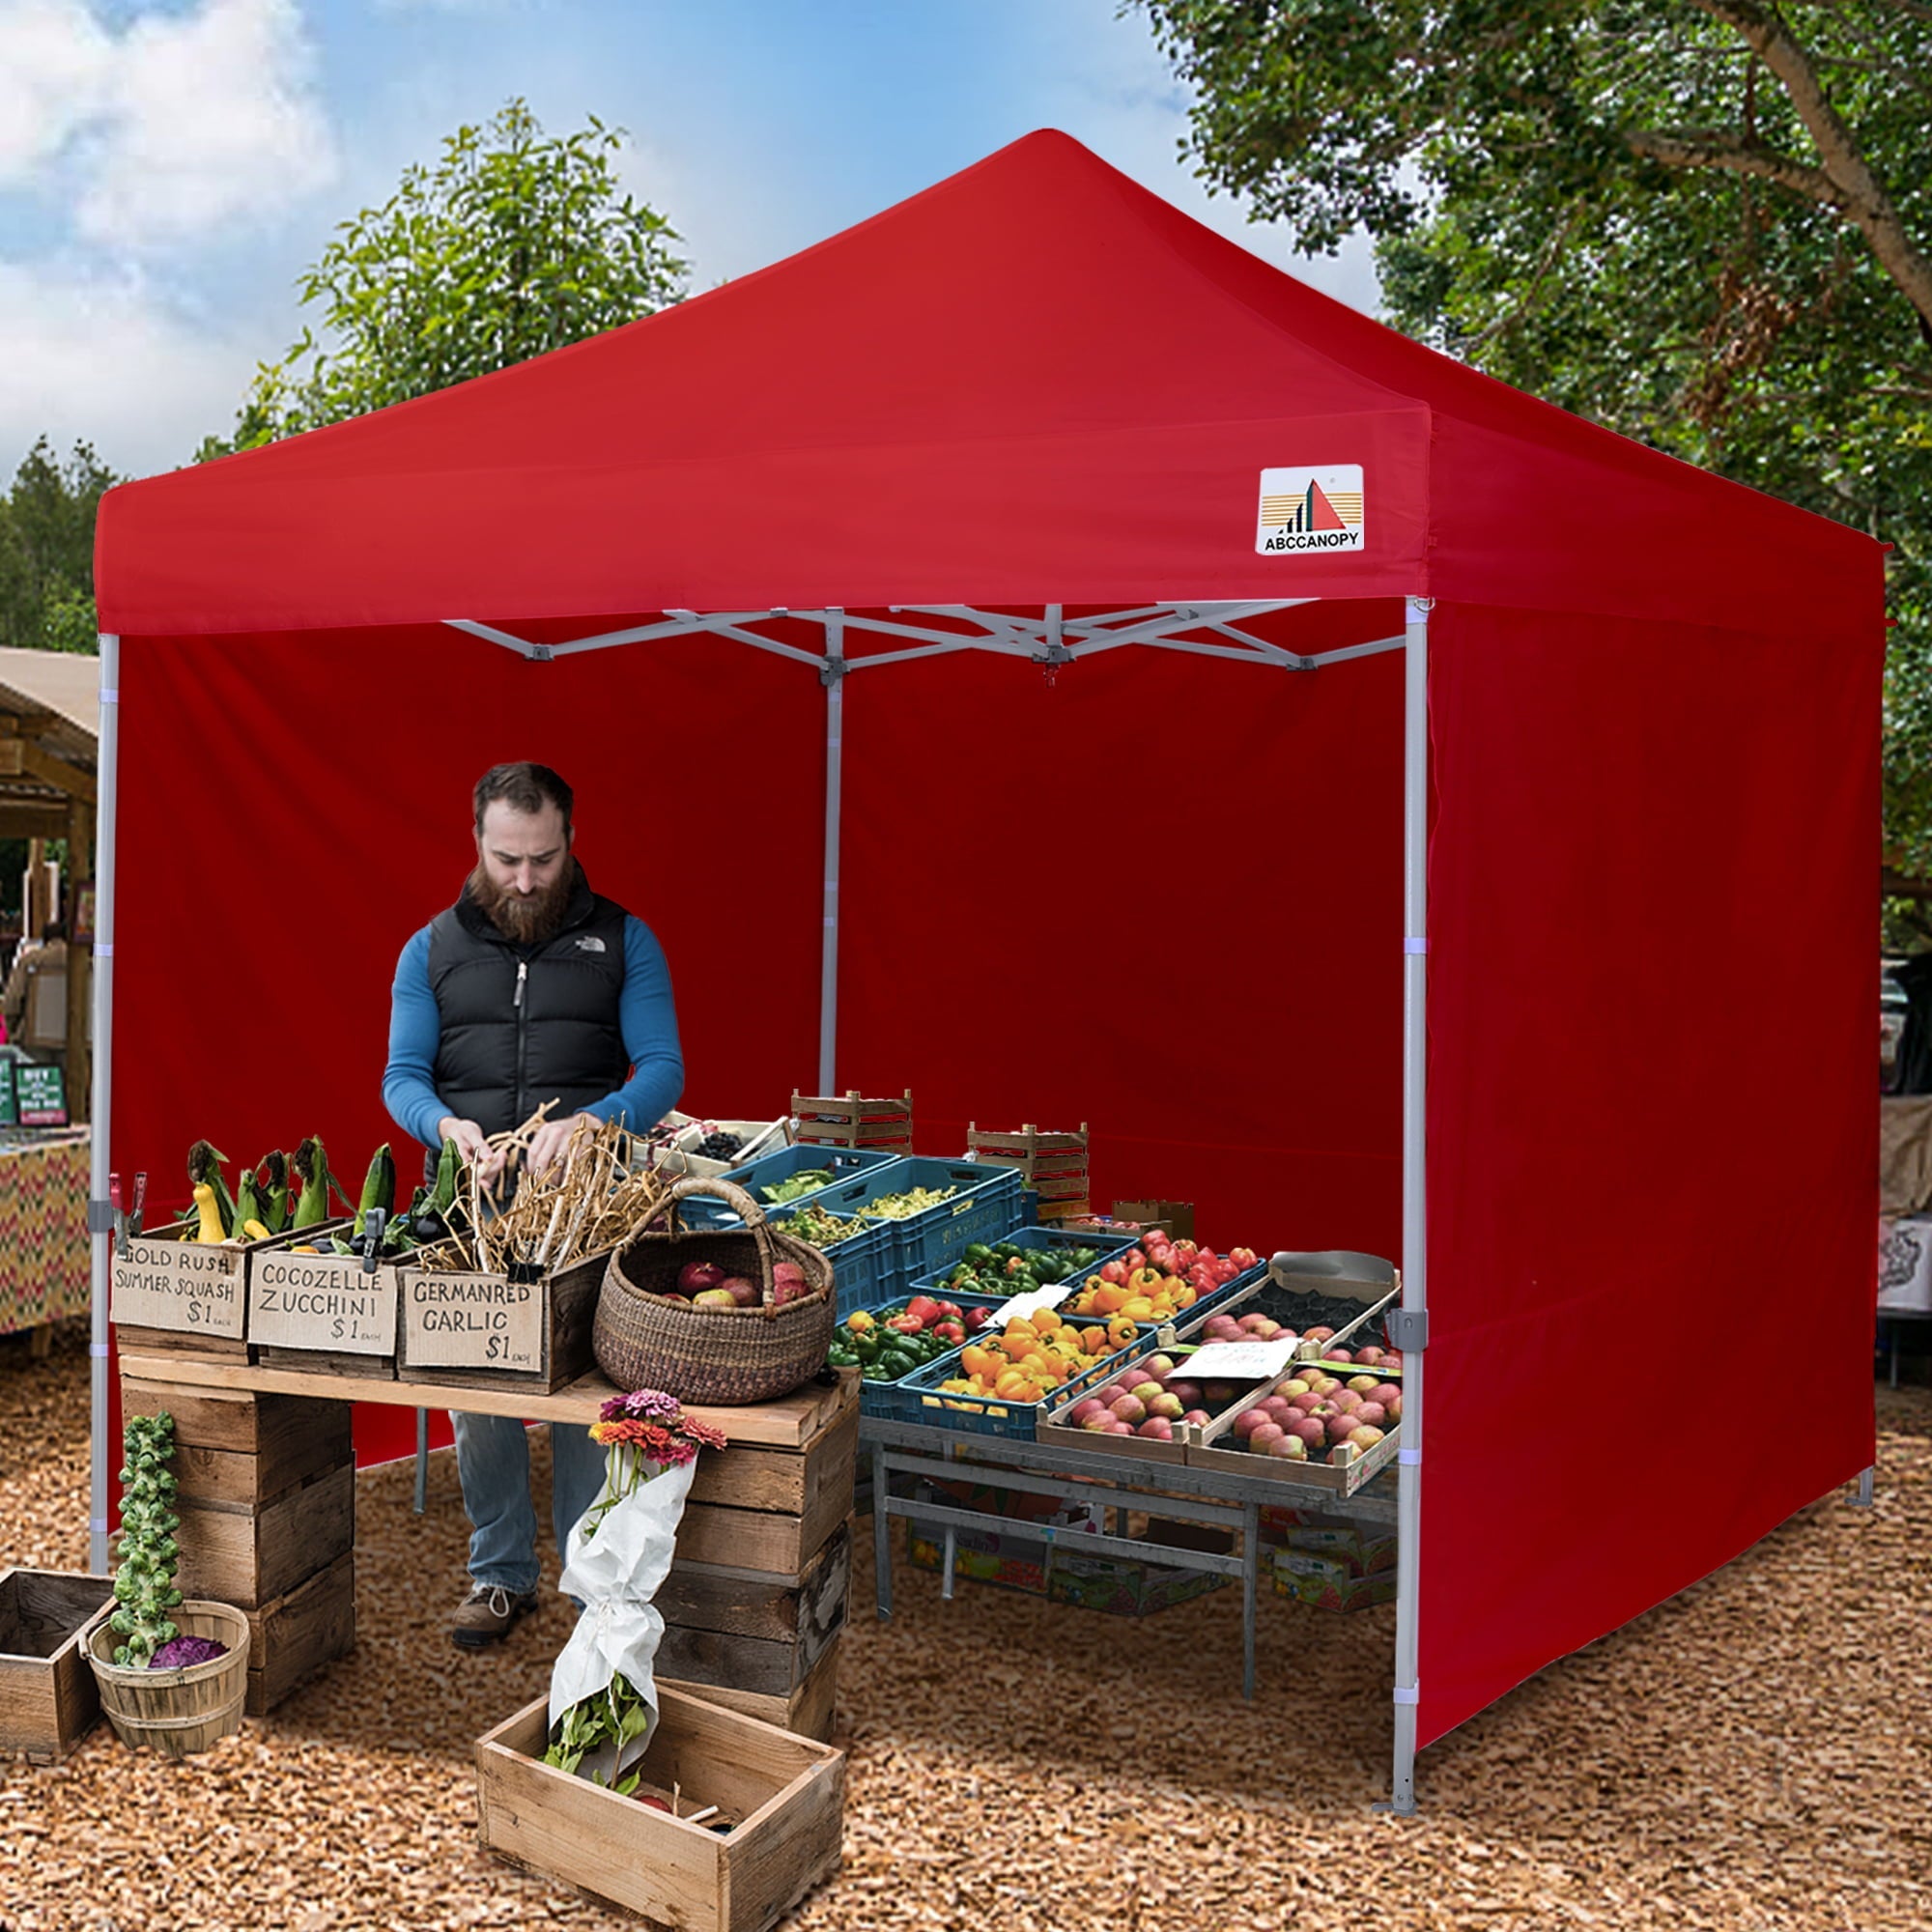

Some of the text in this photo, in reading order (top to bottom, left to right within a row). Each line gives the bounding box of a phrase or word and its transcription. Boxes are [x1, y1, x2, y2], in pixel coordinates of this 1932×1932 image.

[1264, 532, 1358, 551] ABCCANOPY
[179, 1253, 230, 1275] RUSH
[115, 1268, 235, 1303] SUMMER SQUASH
[262, 1264, 383, 1292] COCOZELLE
[187, 1300, 211, 1323] $1
[259, 1289, 375, 1318] ZUCCHINI
[330, 1318, 358, 1339] $1
[423, 1309, 508, 1332] GARLIC
[485, 1333, 510, 1360] $1
